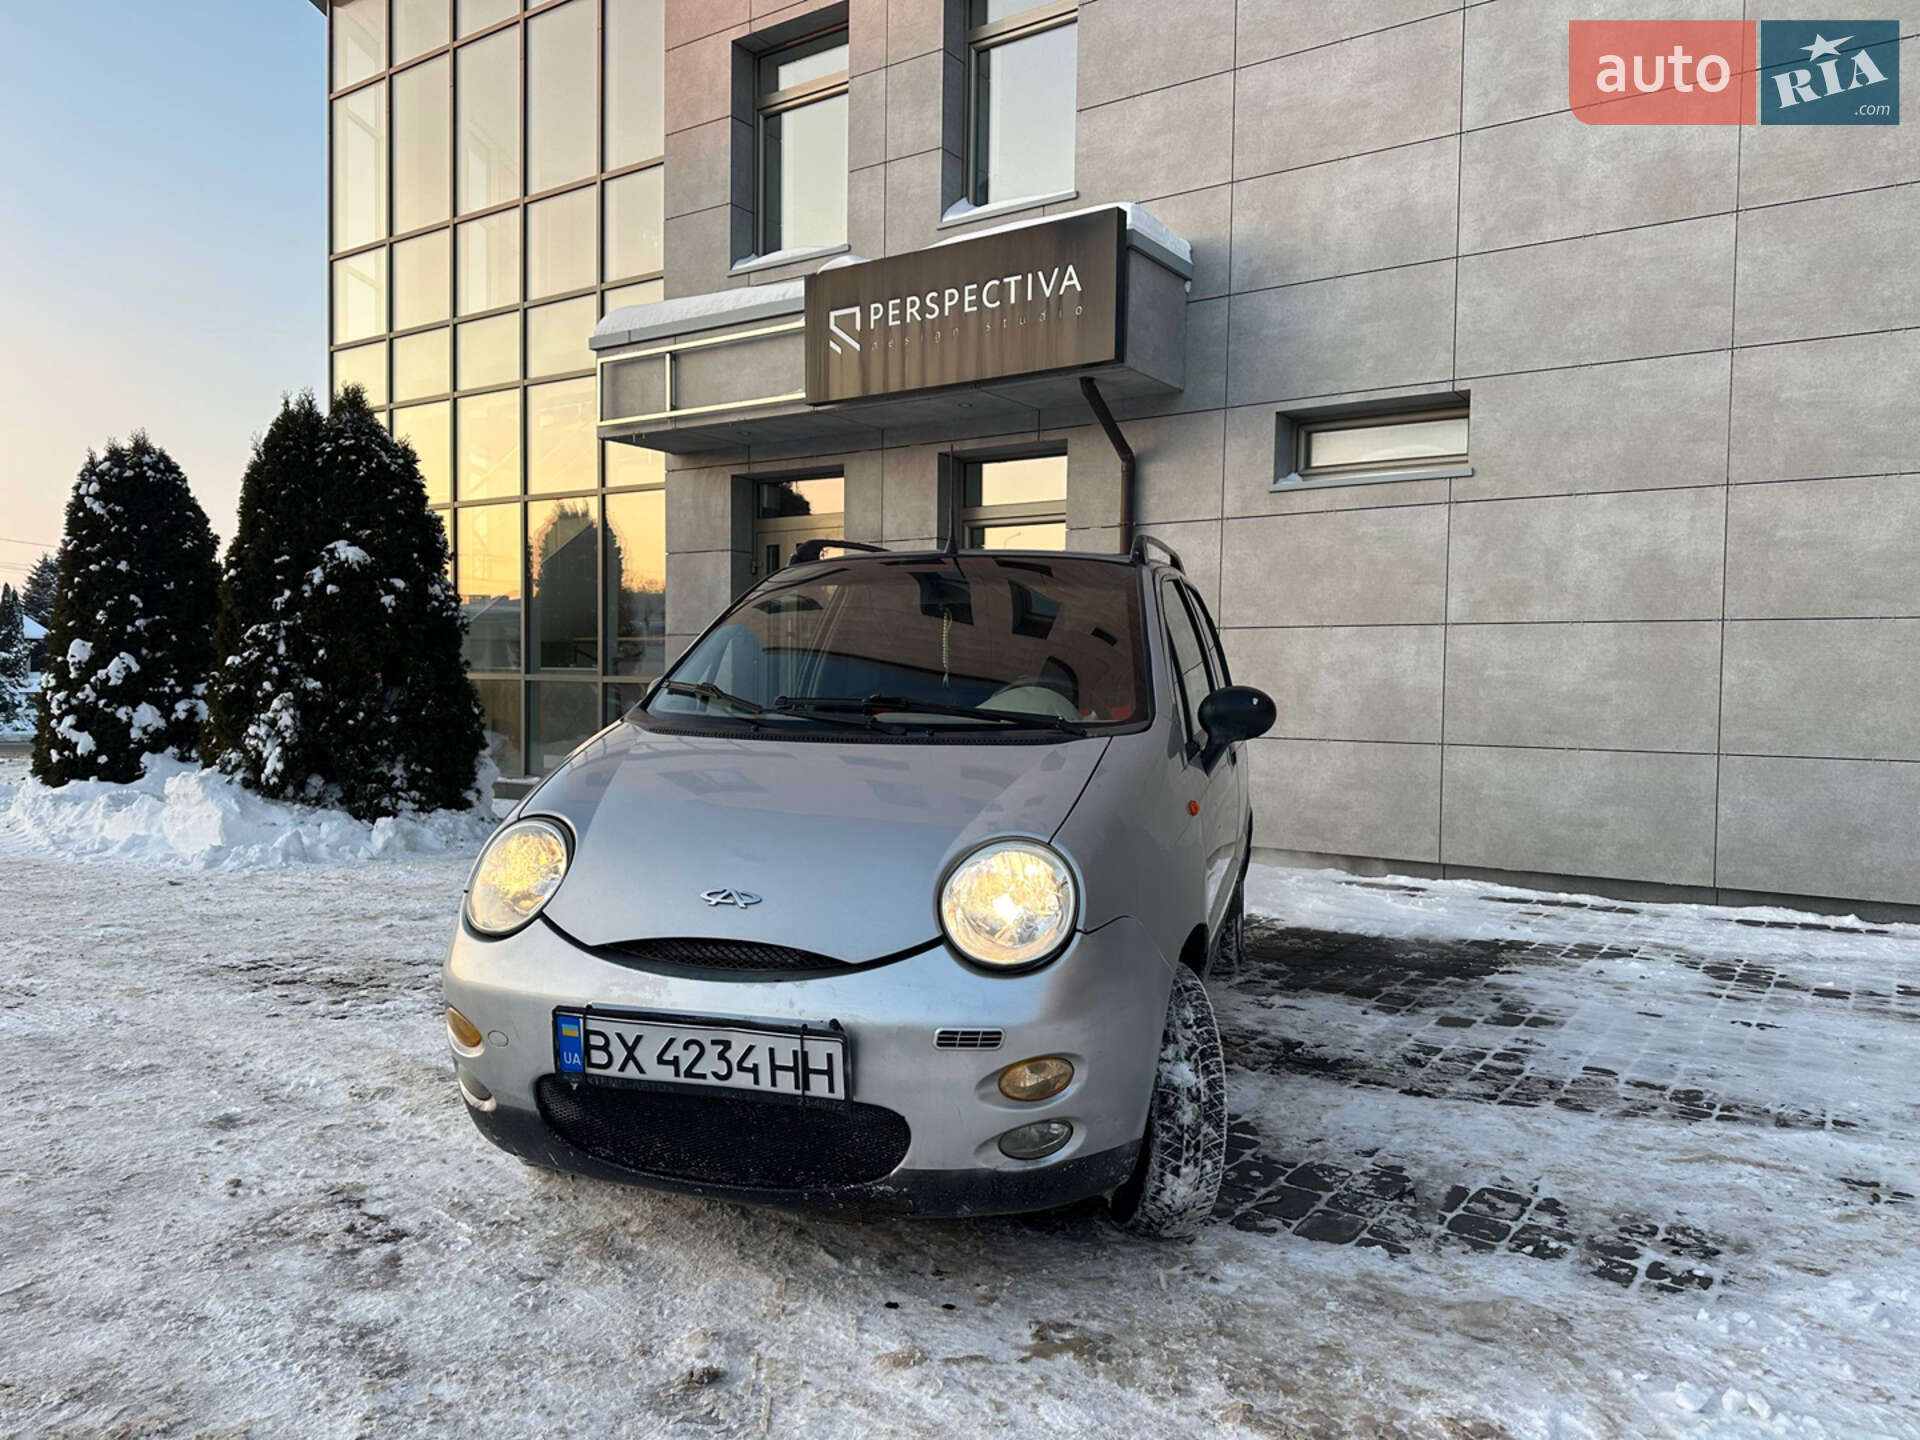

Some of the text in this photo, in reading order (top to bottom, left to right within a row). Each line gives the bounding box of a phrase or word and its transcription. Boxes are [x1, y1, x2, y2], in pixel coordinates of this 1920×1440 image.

[870, 264, 1082, 330] PERSPECTIVA
[563, 1052, 581, 1066] UA
[586, 1029, 647, 1075] BX
